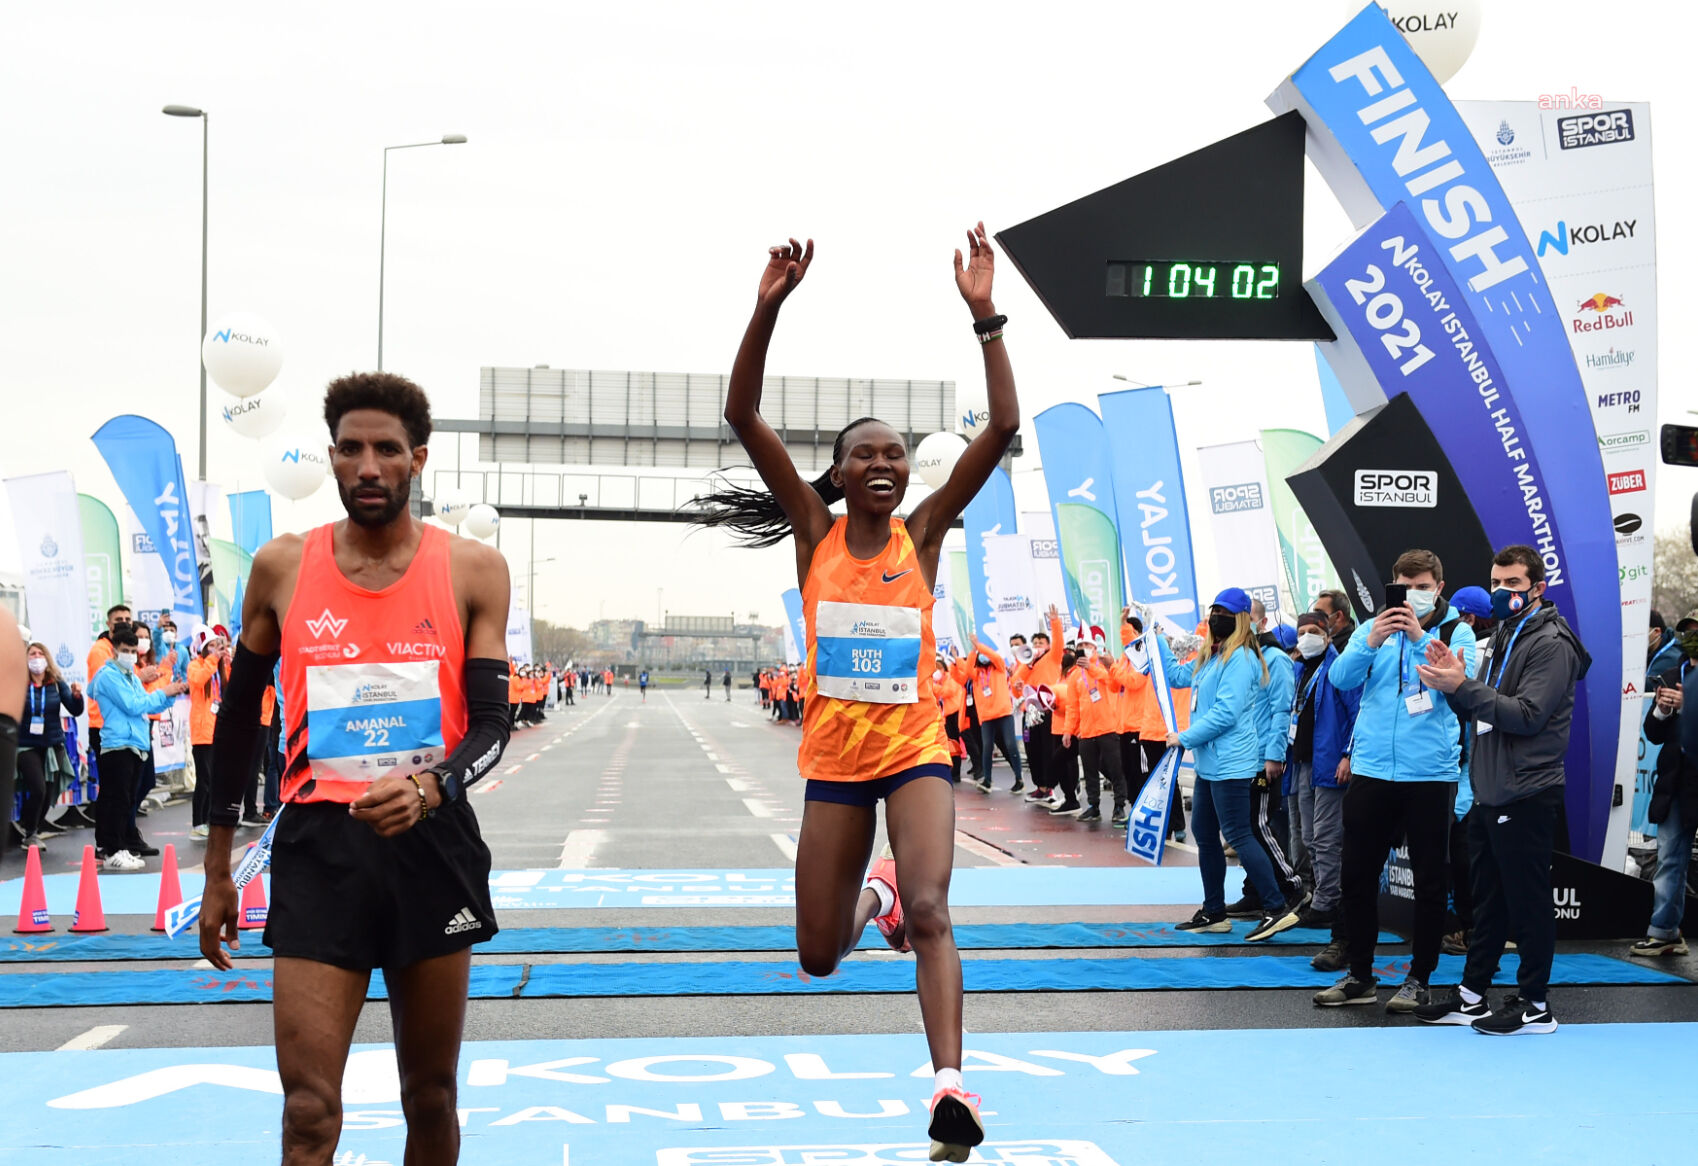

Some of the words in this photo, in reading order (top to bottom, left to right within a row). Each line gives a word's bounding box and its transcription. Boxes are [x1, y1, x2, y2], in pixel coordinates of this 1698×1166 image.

[1391, 12, 1458, 33] KOLAY
[1561, 112, 1629, 137] SPOR
[1328, 45, 1529, 293] FINISH
[1570, 219, 1637, 246] KOLAY
[1143, 265, 1153, 297] 1
[1168, 263, 1216, 298] 04
[1231, 264, 1279, 299] 02
[1344, 263, 1437, 377] 2021
[1573, 315, 1603, 334] Red
[1604, 310, 1634, 329] Bull
[231, 331, 270, 347] KOLAY
[1586, 349, 1635, 369] Hamidiye
[230, 399, 262, 416] KOLAY
[1597, 389, 1641, 408] METRO
[1628, 404, 1641, 414] FM
[1404, 257, 1450, 312] KOLAY
[1440, 314, 1501, 410] ISTANBUL
[1491, 407, 1526, 462] HALF
[1513, 463, 1564, 588] MARATHON
[1360, 474, 1431, 491] SPOR
[1610, 473, 1643, 492] ZÜBER
[386, 642, 446, 657] VIACTIV
[851, 648, 882, 659] RUTH
[851, 658, 882, 673] 103
[345, 715, 407, 733] AMANAL
[364, 729, 390, 747] 22
[444, 921, 482, 935] adidas
[466, 1048, 1158, 1087] KOLAY
[342, 1098, 999, 1131] STANBU
